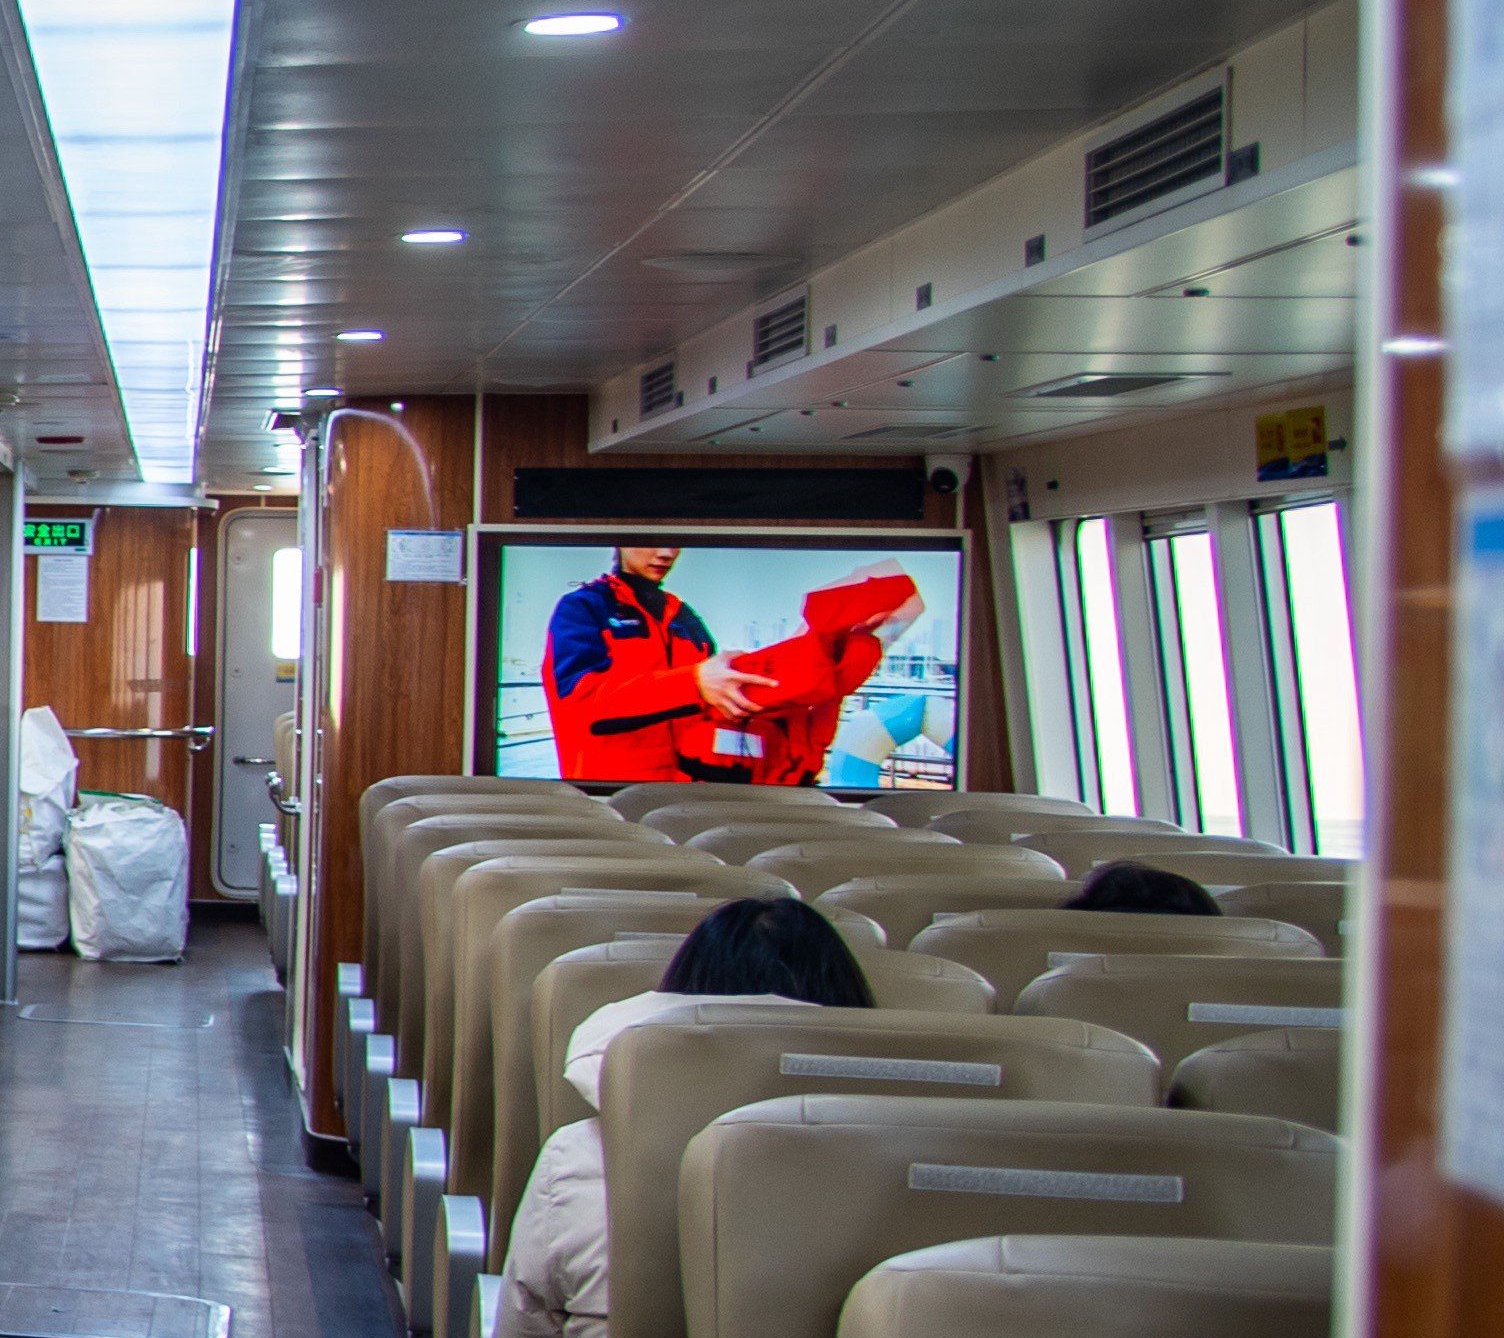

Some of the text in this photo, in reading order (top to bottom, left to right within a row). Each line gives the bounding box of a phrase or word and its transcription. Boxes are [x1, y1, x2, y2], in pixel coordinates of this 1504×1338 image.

[24, 523, 80, 538] 安全出口
[34, 538, 67, 546] EXIT
